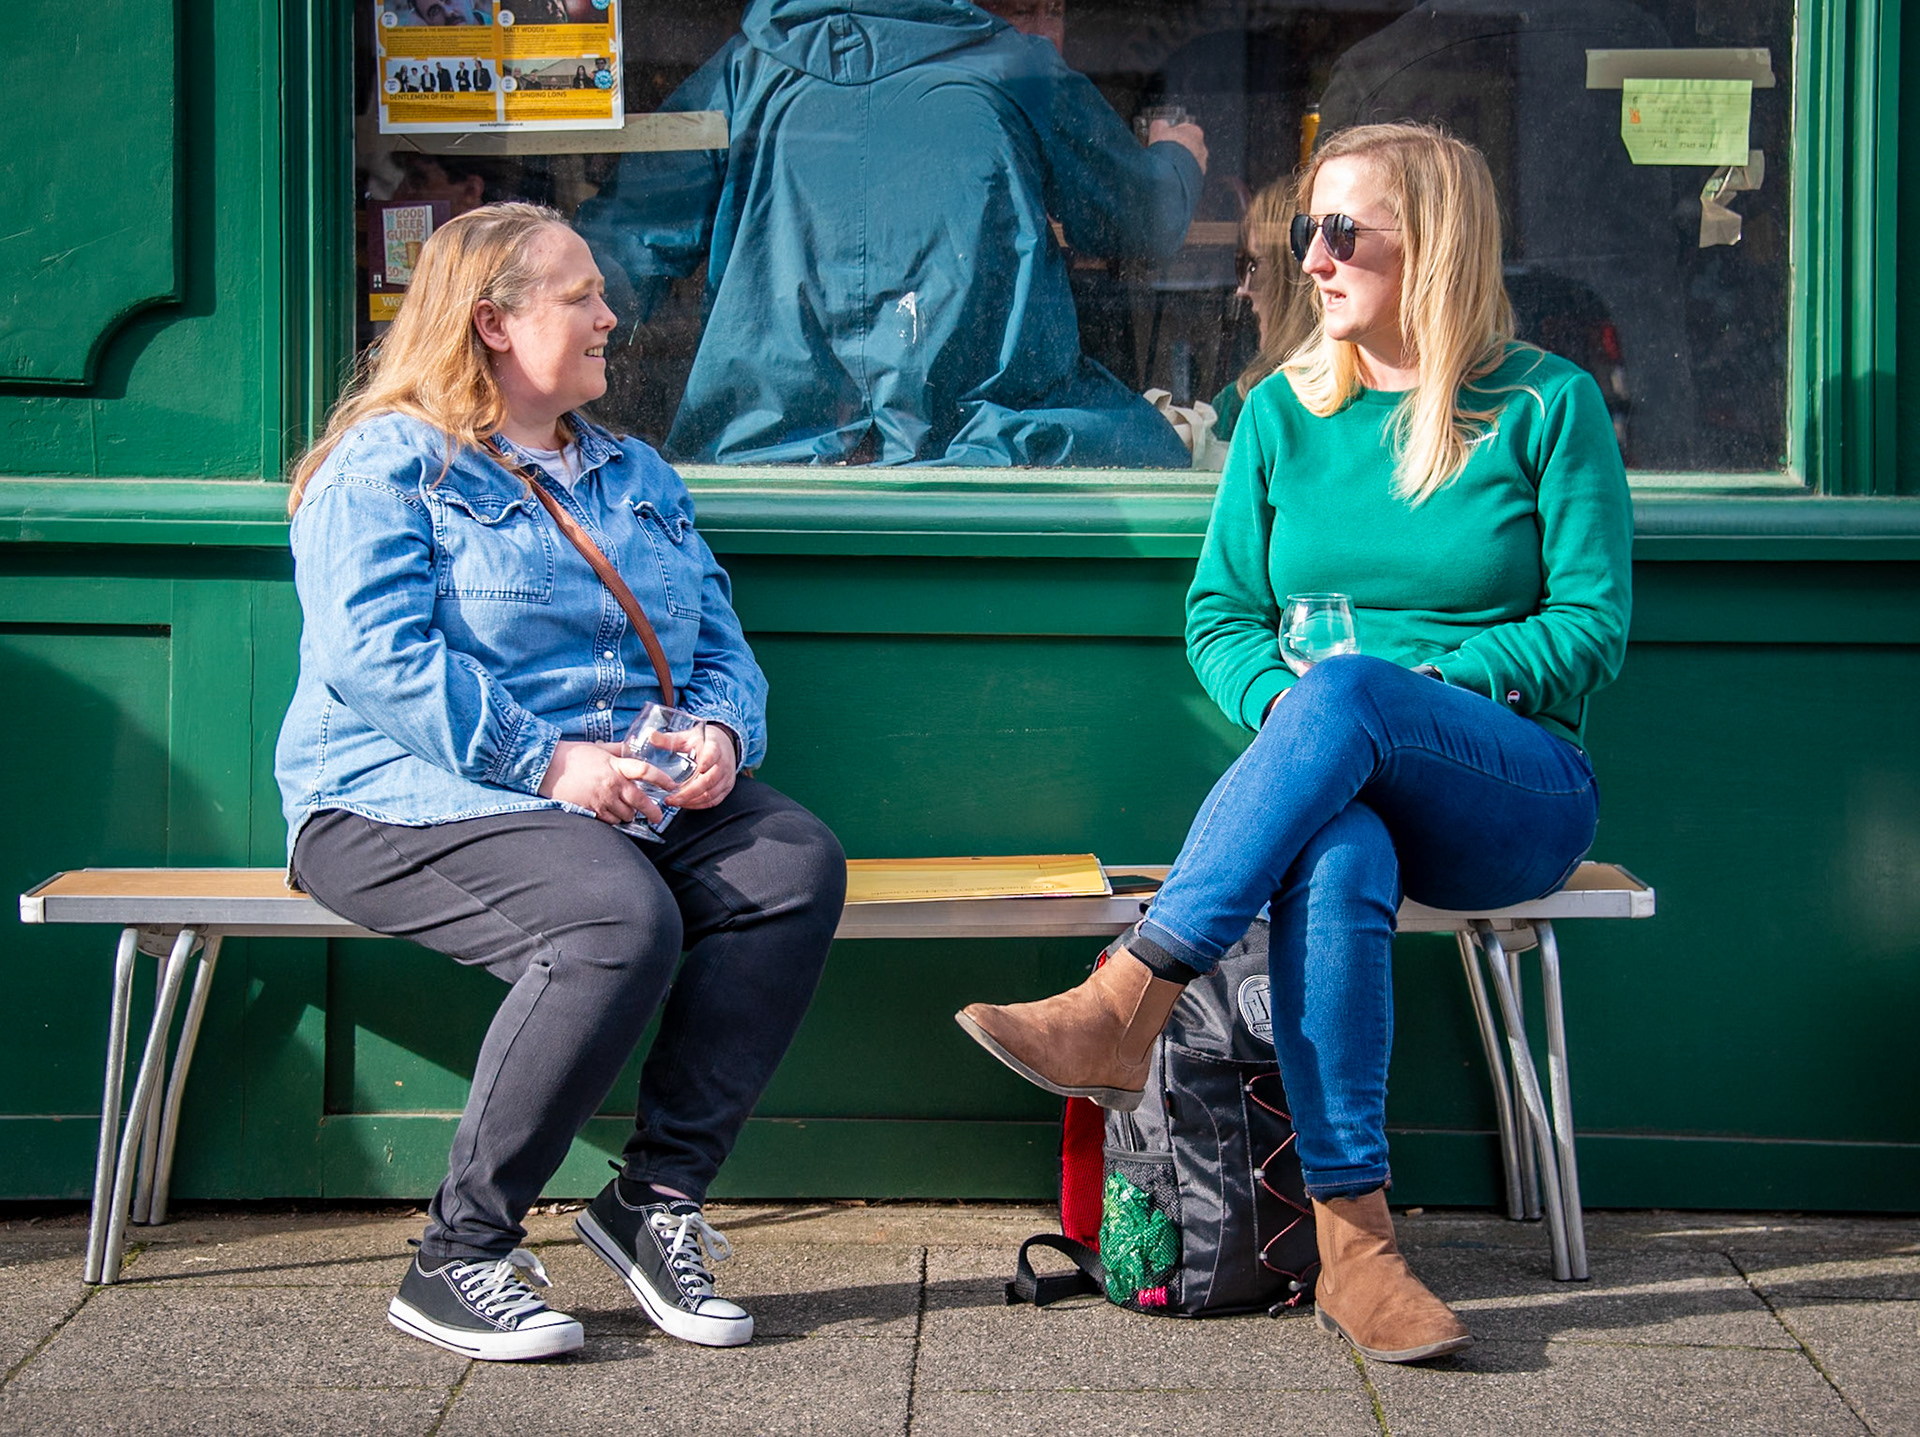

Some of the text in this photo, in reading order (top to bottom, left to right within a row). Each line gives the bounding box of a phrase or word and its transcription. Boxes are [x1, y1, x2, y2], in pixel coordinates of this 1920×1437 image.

[395, 208, 424, 219] GOOD
[396, 219, 424, 229] BEER
[386, 229, 424, 241] GUIDE
